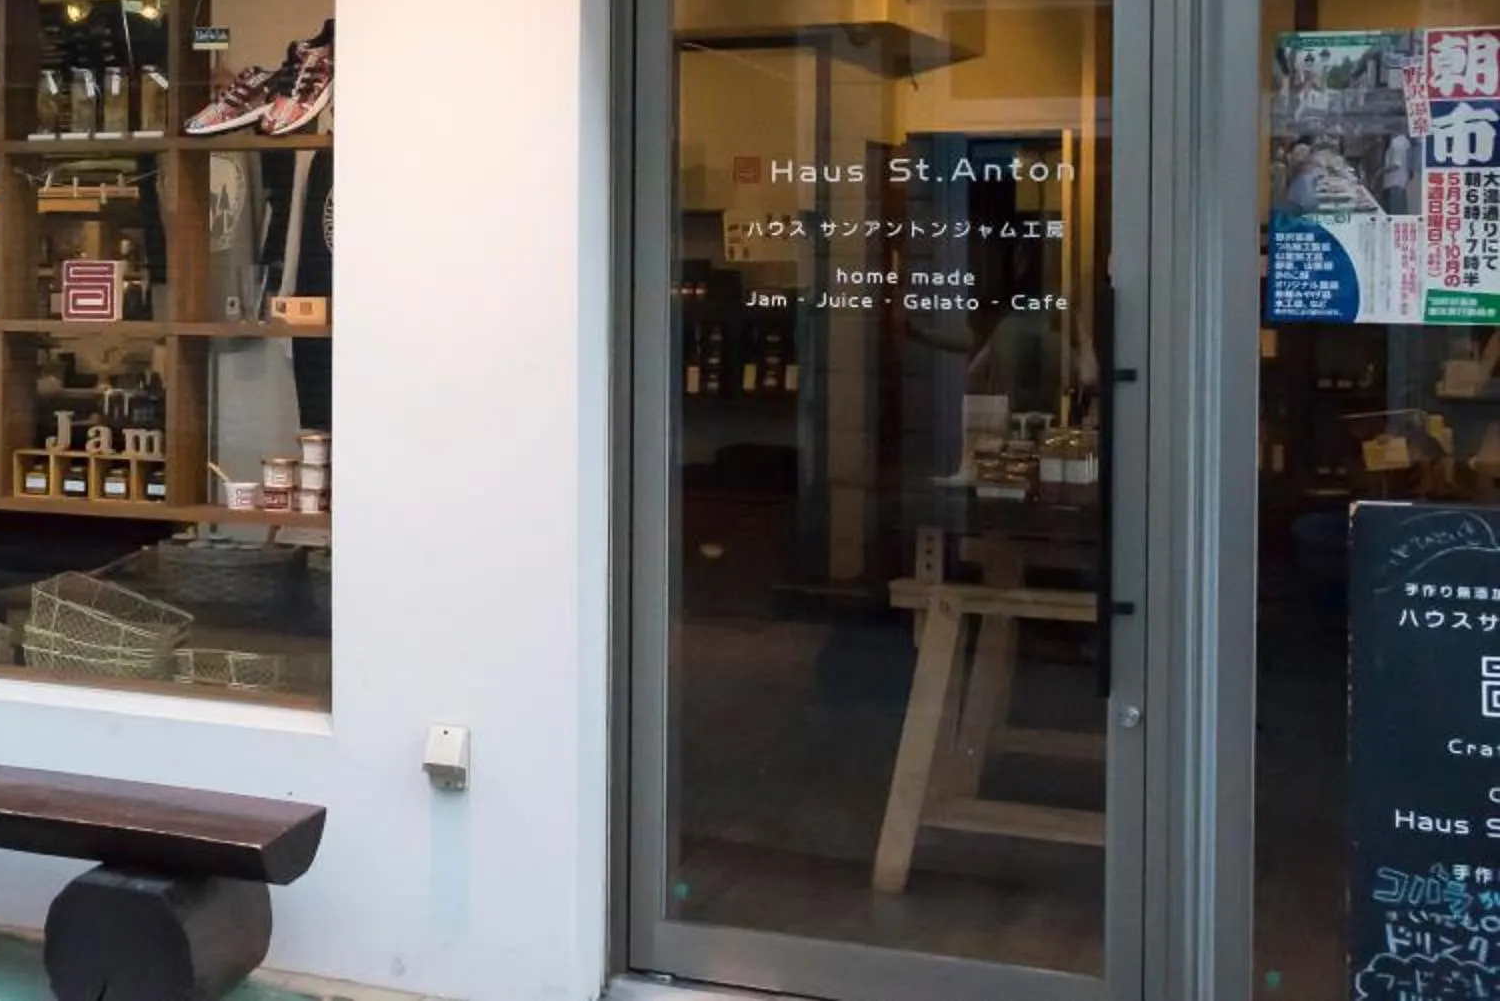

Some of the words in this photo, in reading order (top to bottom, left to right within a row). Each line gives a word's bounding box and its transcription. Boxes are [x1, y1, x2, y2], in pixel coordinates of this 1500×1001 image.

[770, 159, 865, 183] Haus
[888, 156, 1076, 183] St.Anton
[746, 220, 807, 239] ハウス
[835, 267, 899, 285] home
[911, 267, 976, 286] made
[745, 292, 788, 308] Jam
[816, 292, 874, 309] Juice
[903, 293, 980, 311] Gelato
[1010, 293, 1069, 311] Cafe
[45, 409, 164, 457] Jam
[1398, 609, 1499, 632] ハウスサ
[1394, 810, 1470, 835] Haus
